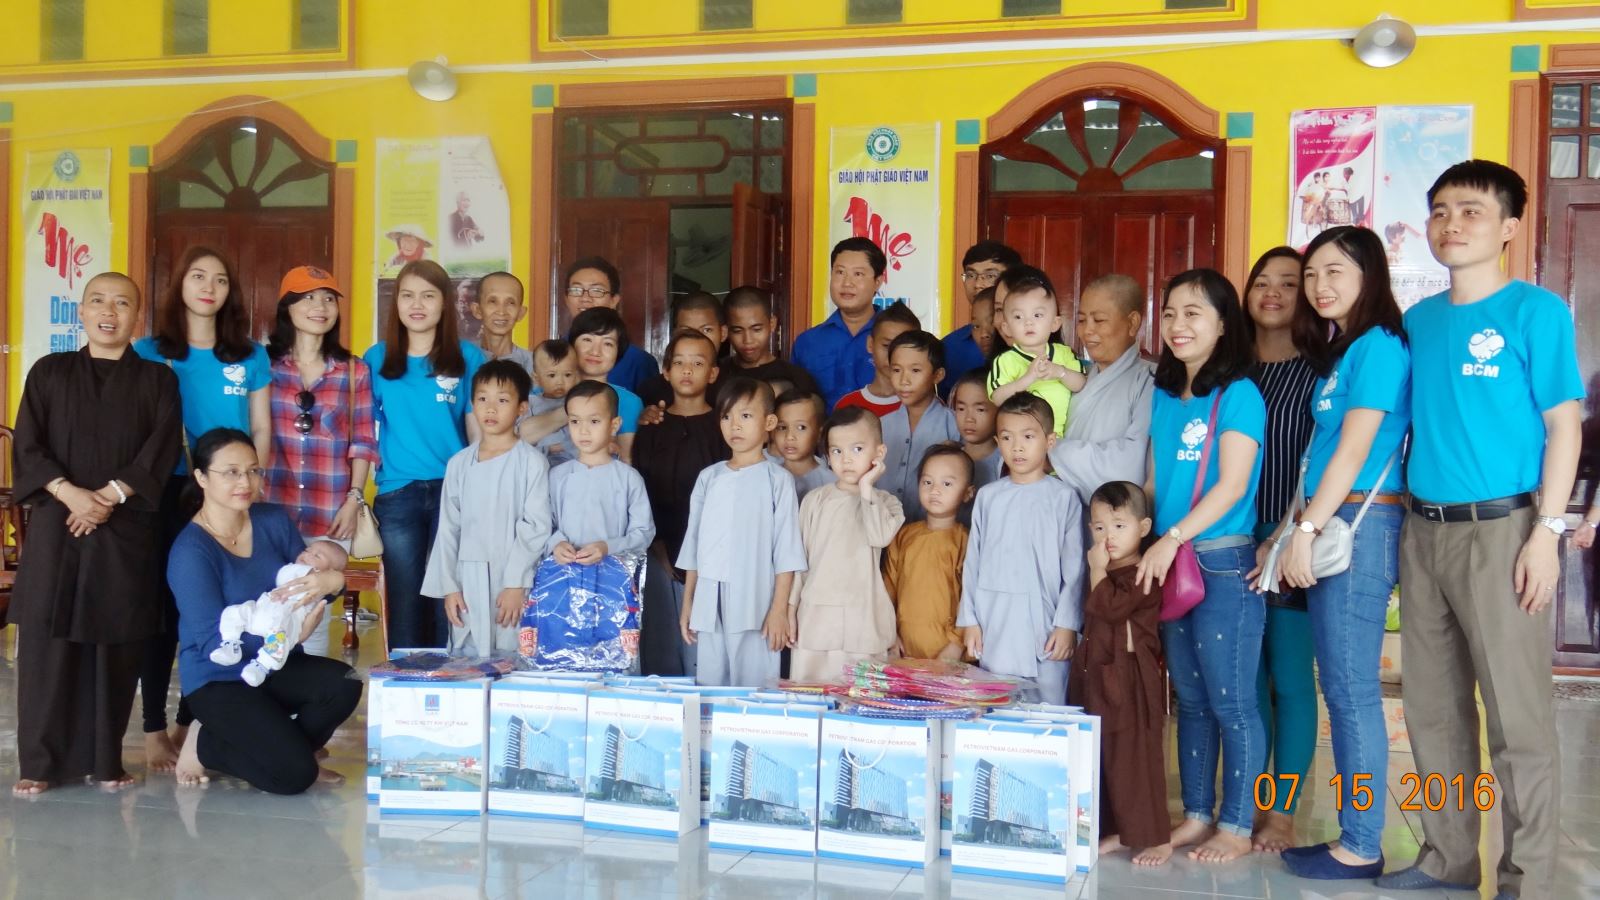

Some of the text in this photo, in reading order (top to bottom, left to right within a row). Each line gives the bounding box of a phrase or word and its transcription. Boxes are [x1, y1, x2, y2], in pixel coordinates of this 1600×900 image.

[838, 168, 929, 185] GIÁO HỘI PHẬT GIÁO VIỆT NAM
[1462, 363, 1500, 378] BCM
[223, 386, 248, 397] BCM
[435, 393, 457, 404] BCM
[963, 744, 1006, 752] PETROVIETNAM
